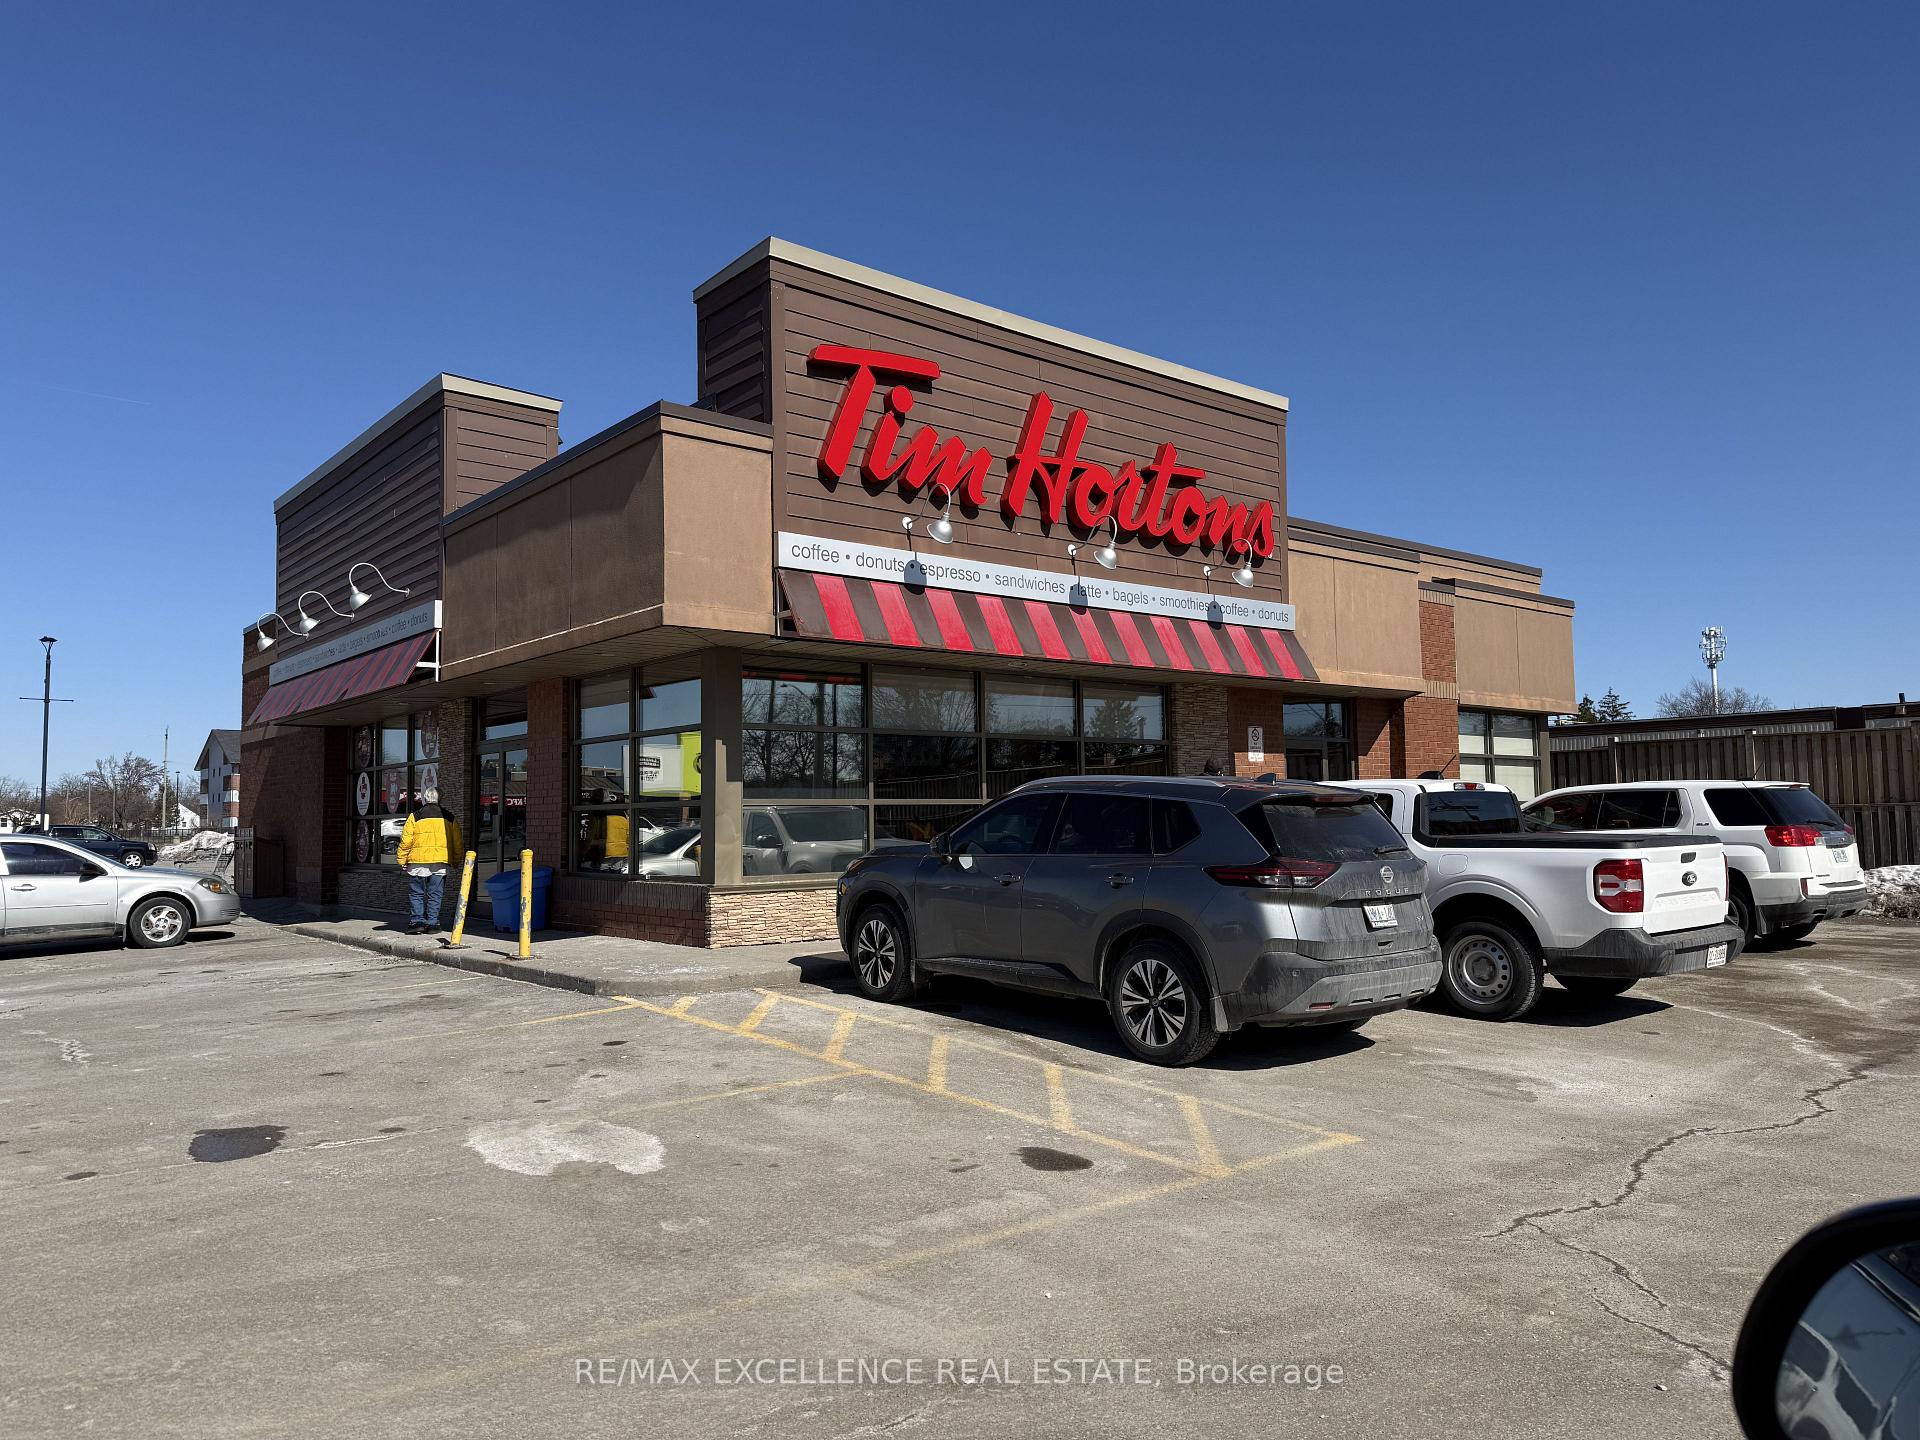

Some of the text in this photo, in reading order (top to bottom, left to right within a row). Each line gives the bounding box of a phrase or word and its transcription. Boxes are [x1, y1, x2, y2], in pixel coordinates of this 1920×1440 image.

[807, 344, 1276, 558] Tim Hortons
[791, 543, 840, 563] coffee
[855, 551, 905, 573] donuts
[919, 563, 981, 583] espresso
[994, 574, 1066, 594] sandwiches
[1112, 588, 1149, 606] bagels
[1159, 595, 1210, 613] smoothies
[1219, 603, 1249, 617] coffee
[1258, 608, 1289, 623] donuts
